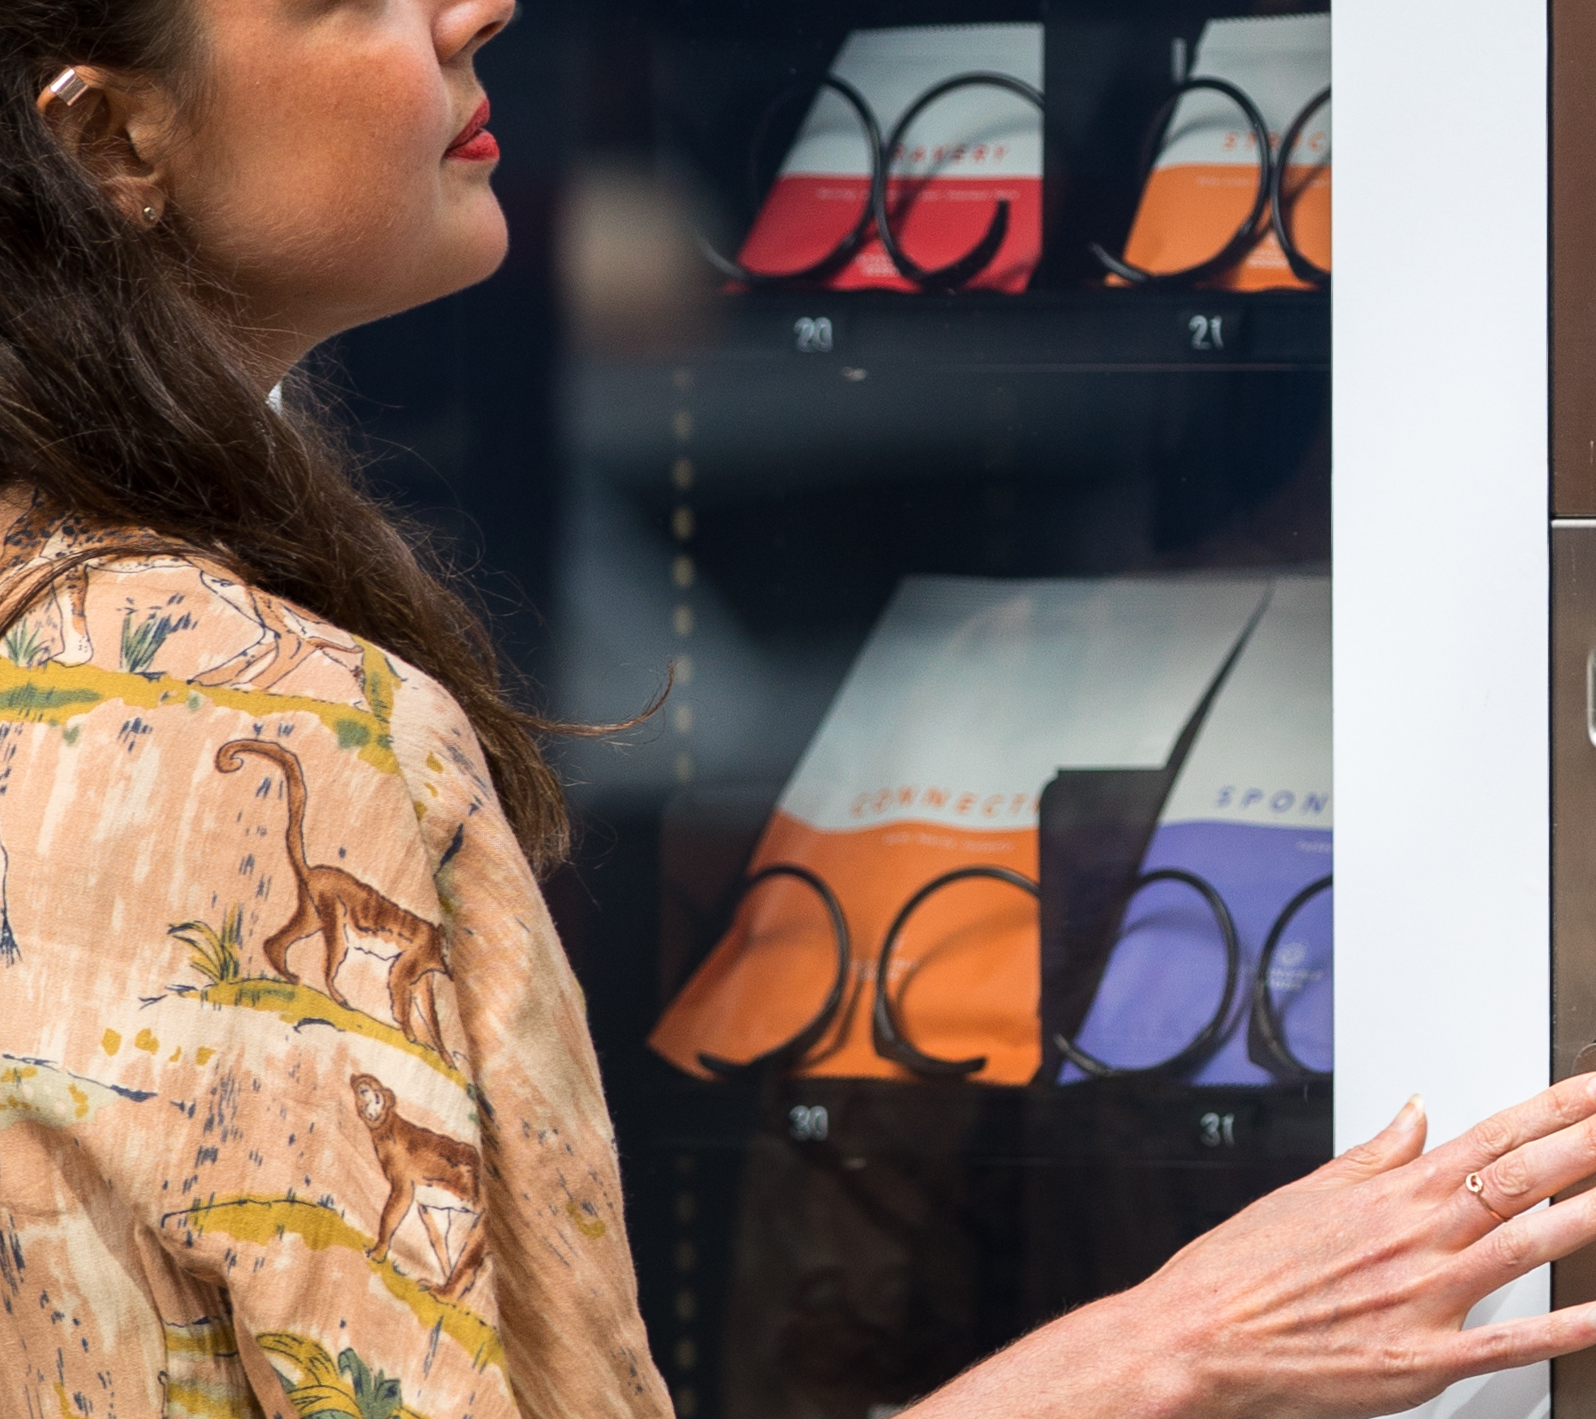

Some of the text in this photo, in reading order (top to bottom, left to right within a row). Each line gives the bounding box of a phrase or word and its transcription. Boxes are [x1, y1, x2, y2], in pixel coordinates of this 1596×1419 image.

[794, 314, 1224, 353] 20 21
[789, 1105, 1235, 1146] 30 31
